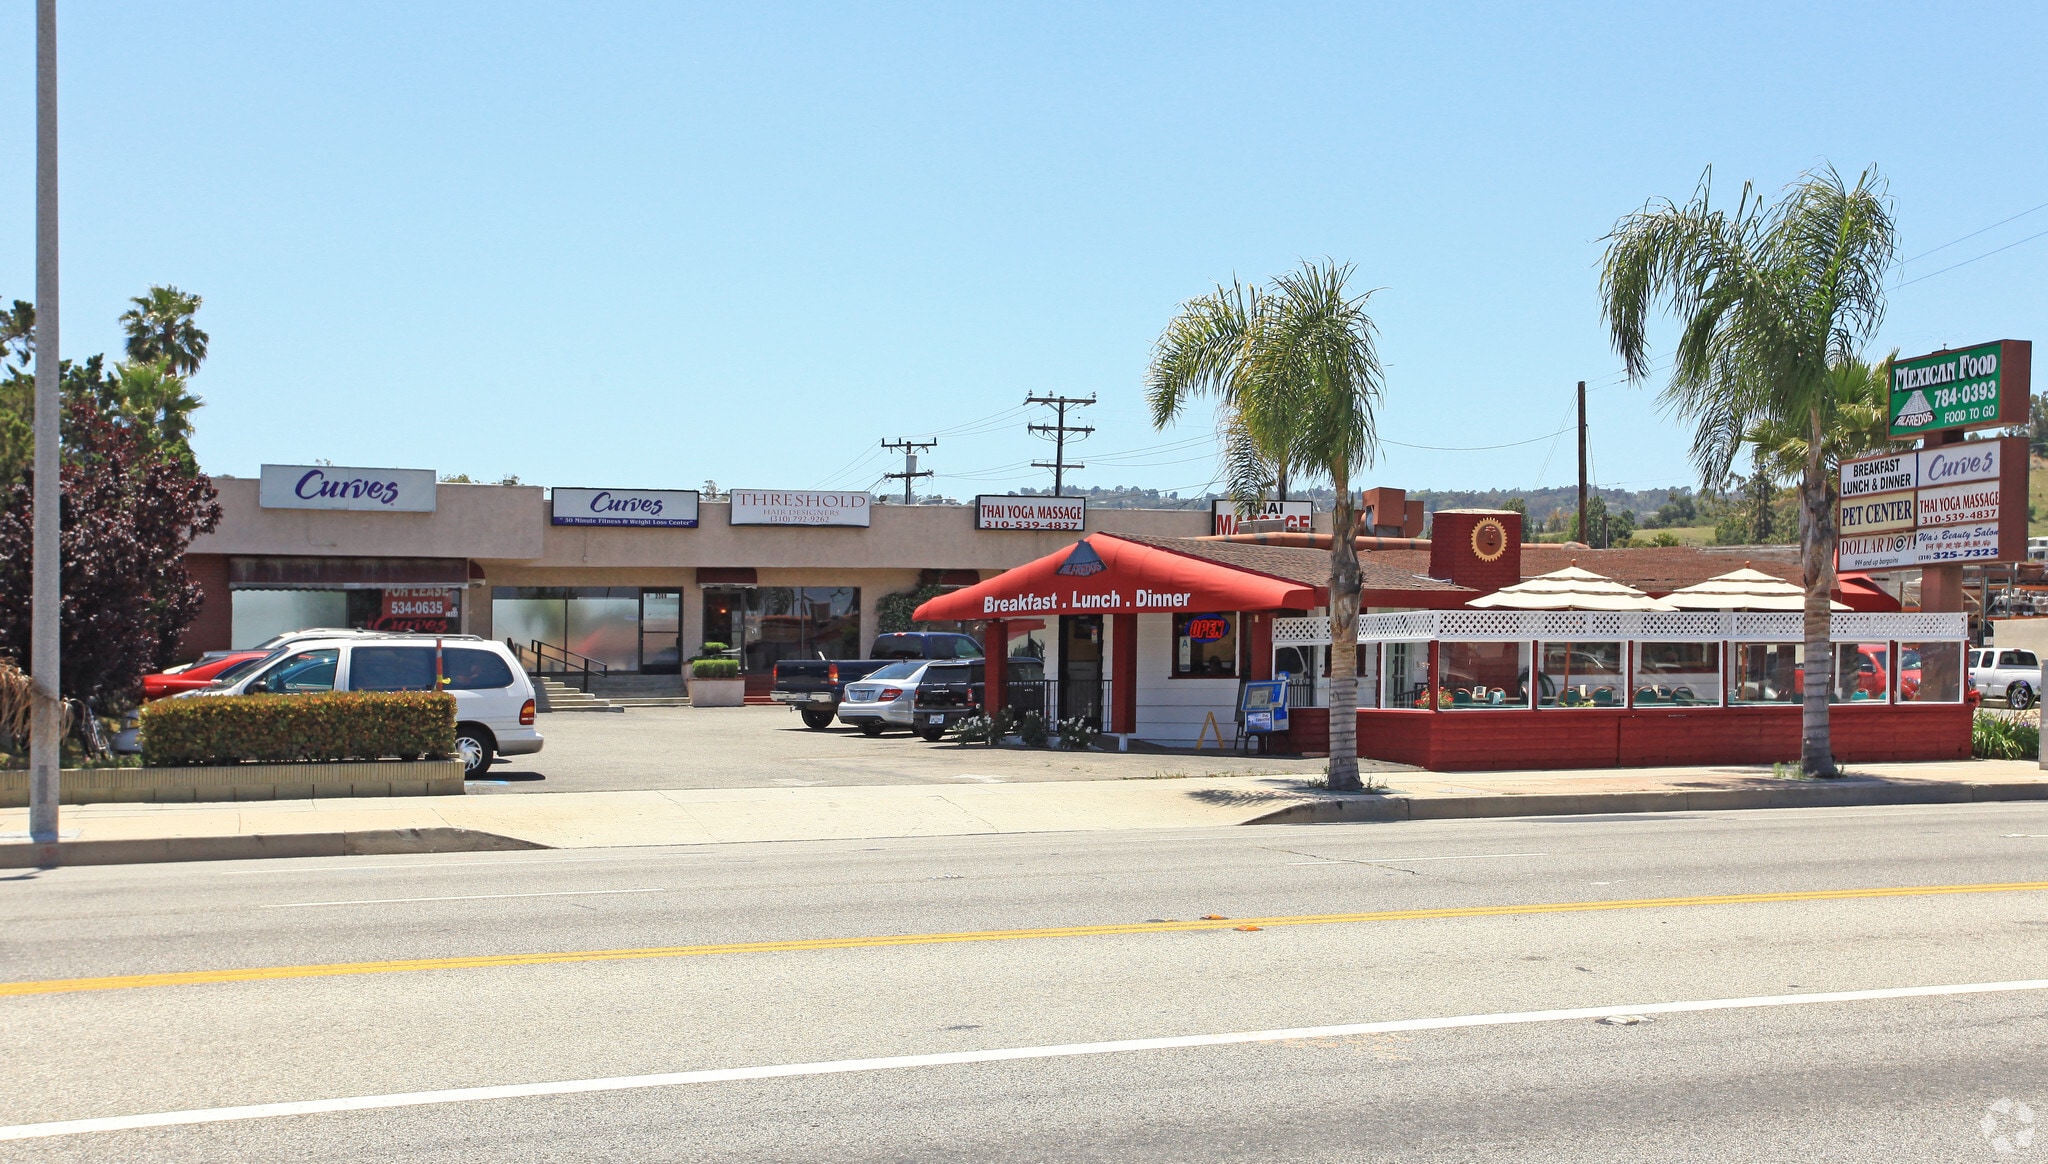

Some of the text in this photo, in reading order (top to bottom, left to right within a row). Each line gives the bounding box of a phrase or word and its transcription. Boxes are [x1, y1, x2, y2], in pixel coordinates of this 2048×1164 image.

[1895, 354, 1996, 391] MEXICAN FOOD
[1895, 412, 1933, 426] ALFREDOS
[1945, 405, 1994, 423] FOOD TO GO
[1853, 458, 1900, 477] BREAKFAST
[1928, 452, 1993, 480] Curves
[295, 470, 398, 504] Curves
[1842, 474, 1911, 495] LUNCH & DINNER
[590, 492, 663, 515] Curves
[737, 493, 866, 508] THRESHOLD
[1920, 492, 1999, 514] THAI YOGA MASSAGE
[982, 505, 1082, 519] THAI YOGA MASSAGE
[1842, 500, 1912, 526] PET CENTER
[1922, 509, 1996, 524] 310-539-4837
[984, 520, 1078, 529] 310-539-4837
[1216, 514, 1310, 535] MAGE
[1919, 527, 1999, 541] Wa's Beauty Salon
[1842, 537, 1884, 555] DOLLAR
[1933, 548, 1998, 559] 325-7323
[1863, 558, 1872, 566] and
[1879, 557, 1898, 565] bargains
[385, 588, 449, 597] FOR LEASE
[984, 592, 1057, 612] Breakfast
[1072, 590, 1120, 608] Lunch
[1136, 589, 1190, 608] Dinner
[374, 615, 448, 632] Curves
[1190, 619, 1225, 638] OPEN
[1182, 639, 1188, 648] A
